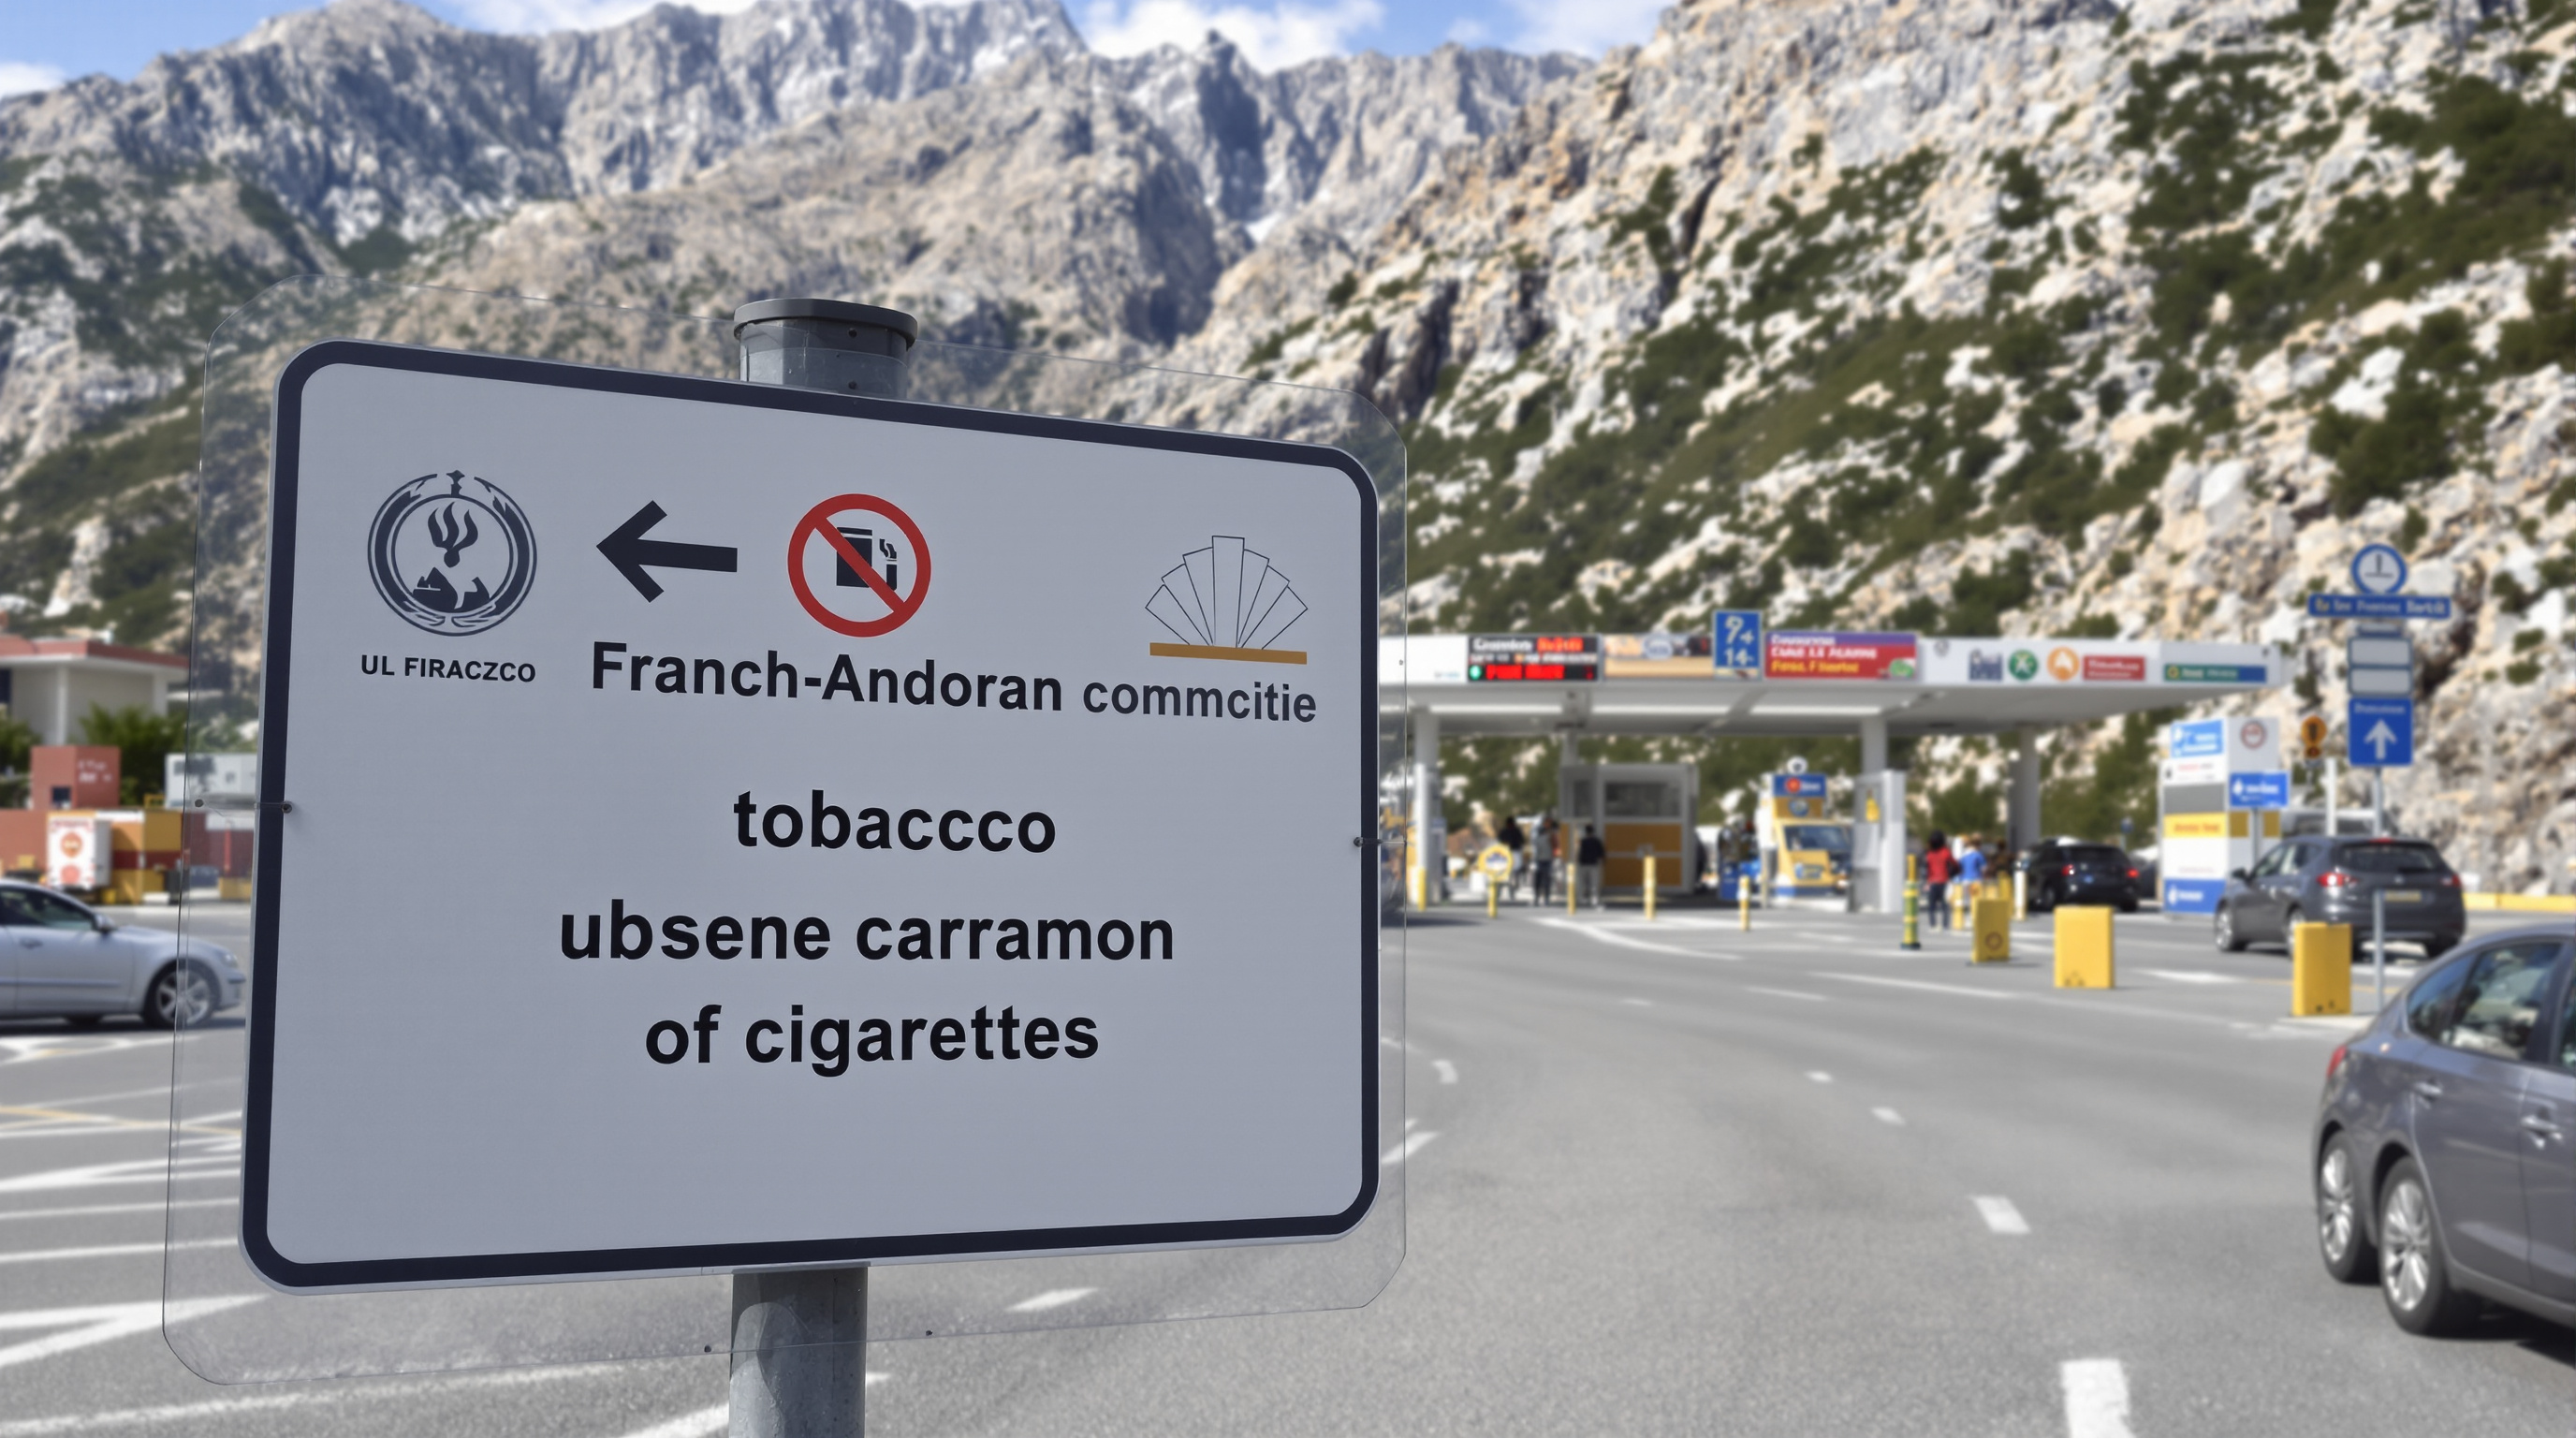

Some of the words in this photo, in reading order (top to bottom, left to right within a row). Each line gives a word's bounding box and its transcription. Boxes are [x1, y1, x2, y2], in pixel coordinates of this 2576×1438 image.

[361, 654, 395, 676] UL
[404, 656, 536, 683] FIRACZCO
[592, 640, 1062, 712] Franch-Andoran
[1082, 680, 1317, 724] commcitie
[733, 788, 1057, 854] tobaccco
[560, 898, 832, 961] ubsene
[855, 917, 1174, 961] carramon
[644, 1004, 724, 1065] of
[744, 1004, 1100, 1078] cigarettes
